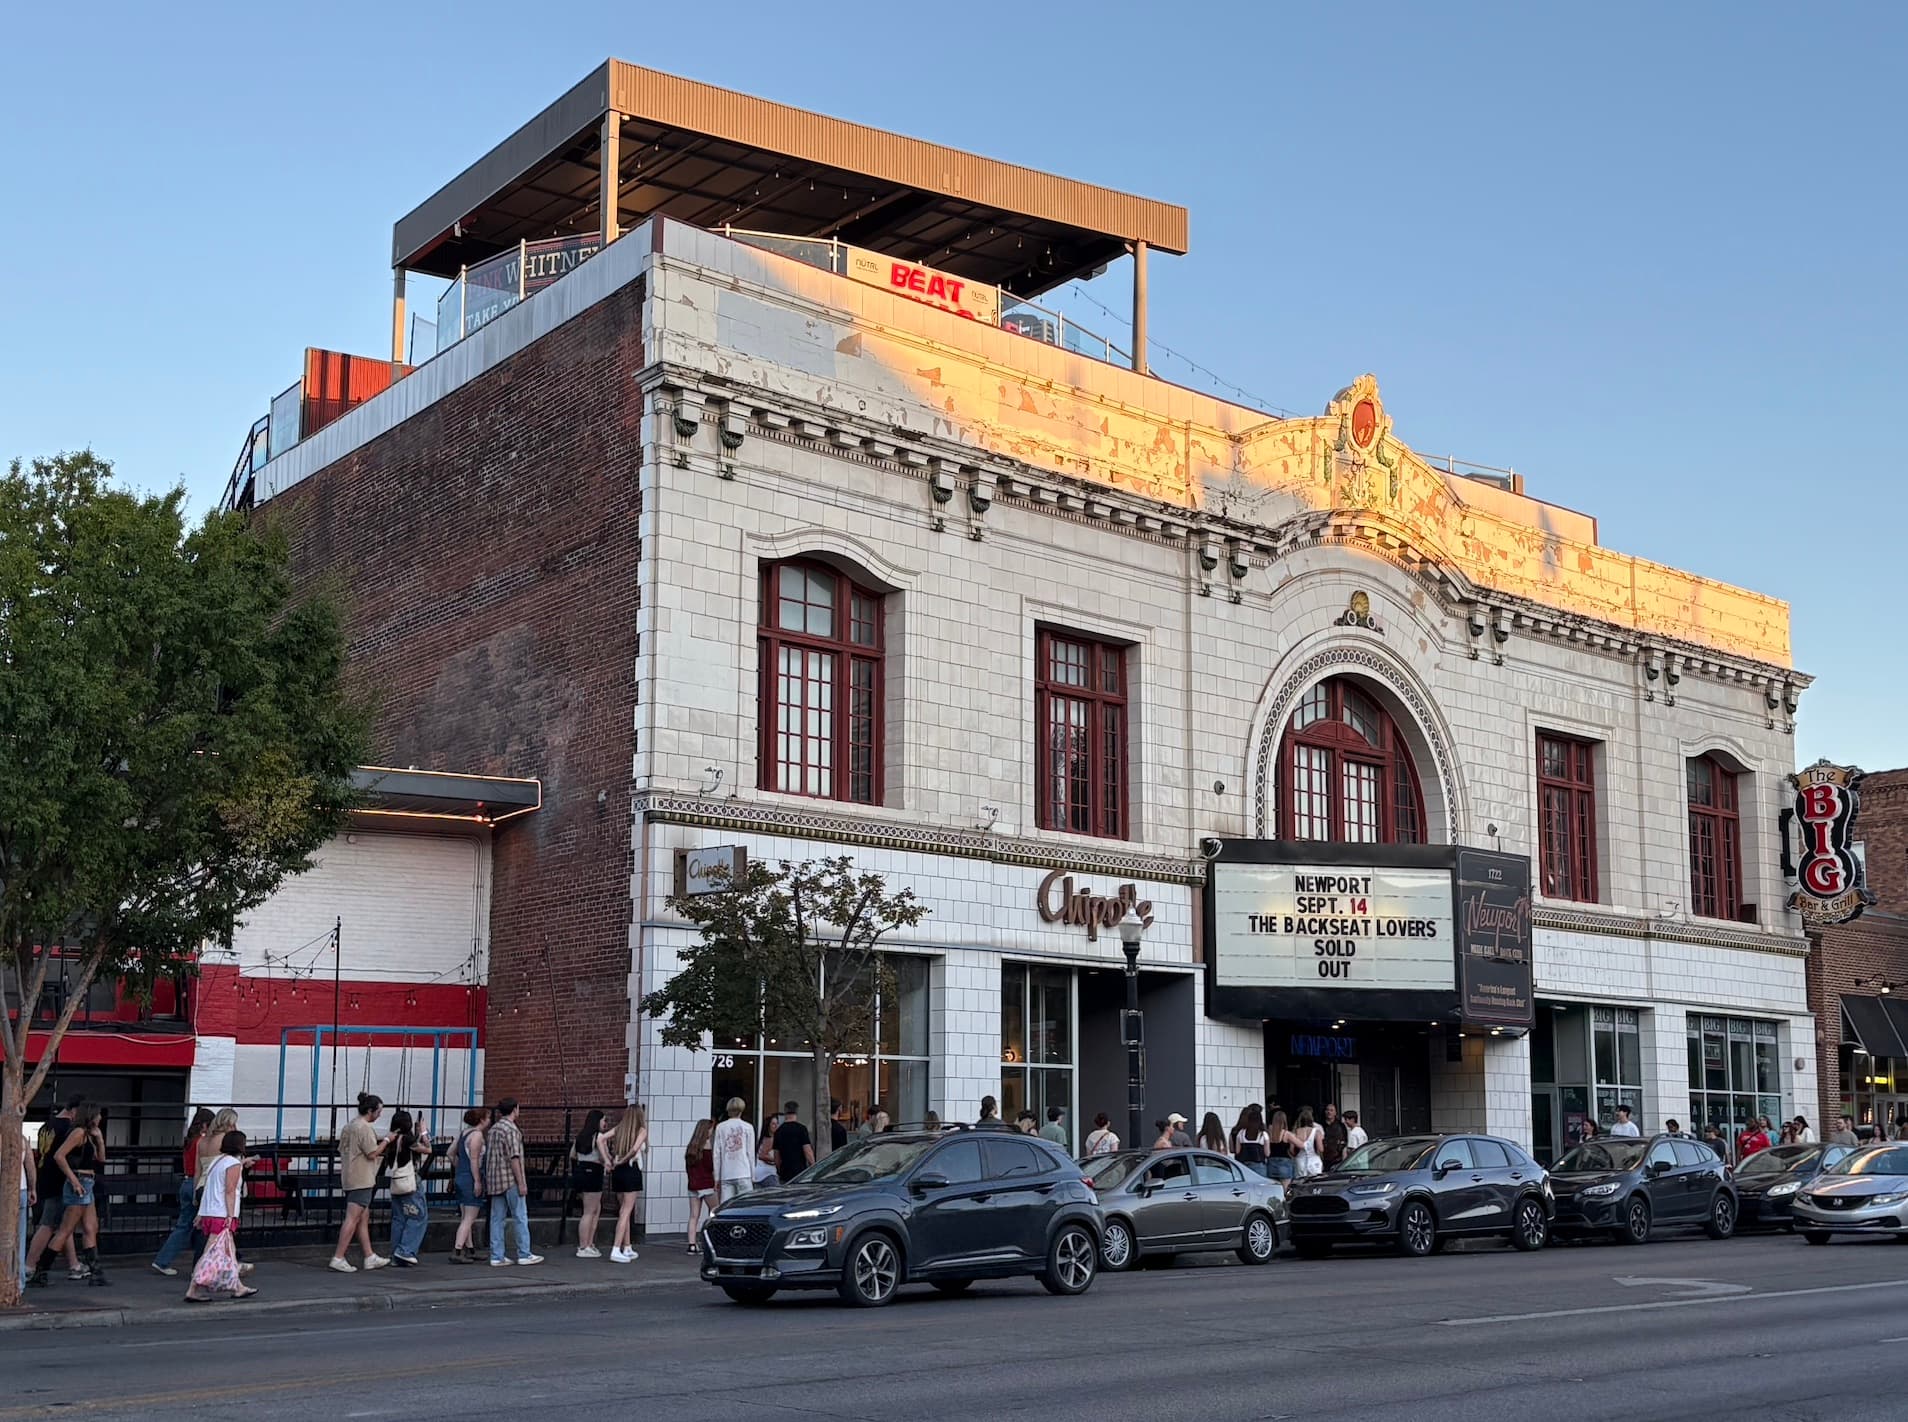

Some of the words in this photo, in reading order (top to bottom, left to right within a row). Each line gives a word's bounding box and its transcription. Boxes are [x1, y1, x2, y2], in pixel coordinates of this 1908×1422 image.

[891, 263, 965, 303] BEAT
[466, 304, 498, 330] TAKE
[1807, 769, 1836, 782] The
[1802, 785, 1843, 893] BIG
[1488, 868, 1503, 880] 1722
[1295, 875, 1371, 895] NEWPORT
[1297, 896, 1344, 915] SEPT.
[1350, 897, 1368, 915] 14
[1799, 896, 1819, 910] Bar
[1821, 900, 1829, 911] &
[1831, 894, 1853, 910] Grill
[1249, 915, 1277, 933] THE
[1284, 917, 1371, 937] BACKSEAT
[1376, 919, 1437, 938] LOVERS
[1467, 890, 1524, 953] Newport
[1314, 939, 1356, 957] SOLD
[1318, 960, 1351, 978] OUT
[1704, 1017, 1720, 1031] BIG
[1730, 1019, 1746, 1033] BIG
[1756, 1022, 1772, 1035] BIG
[1291, 1034, 1356, 1058] NEWPORT
